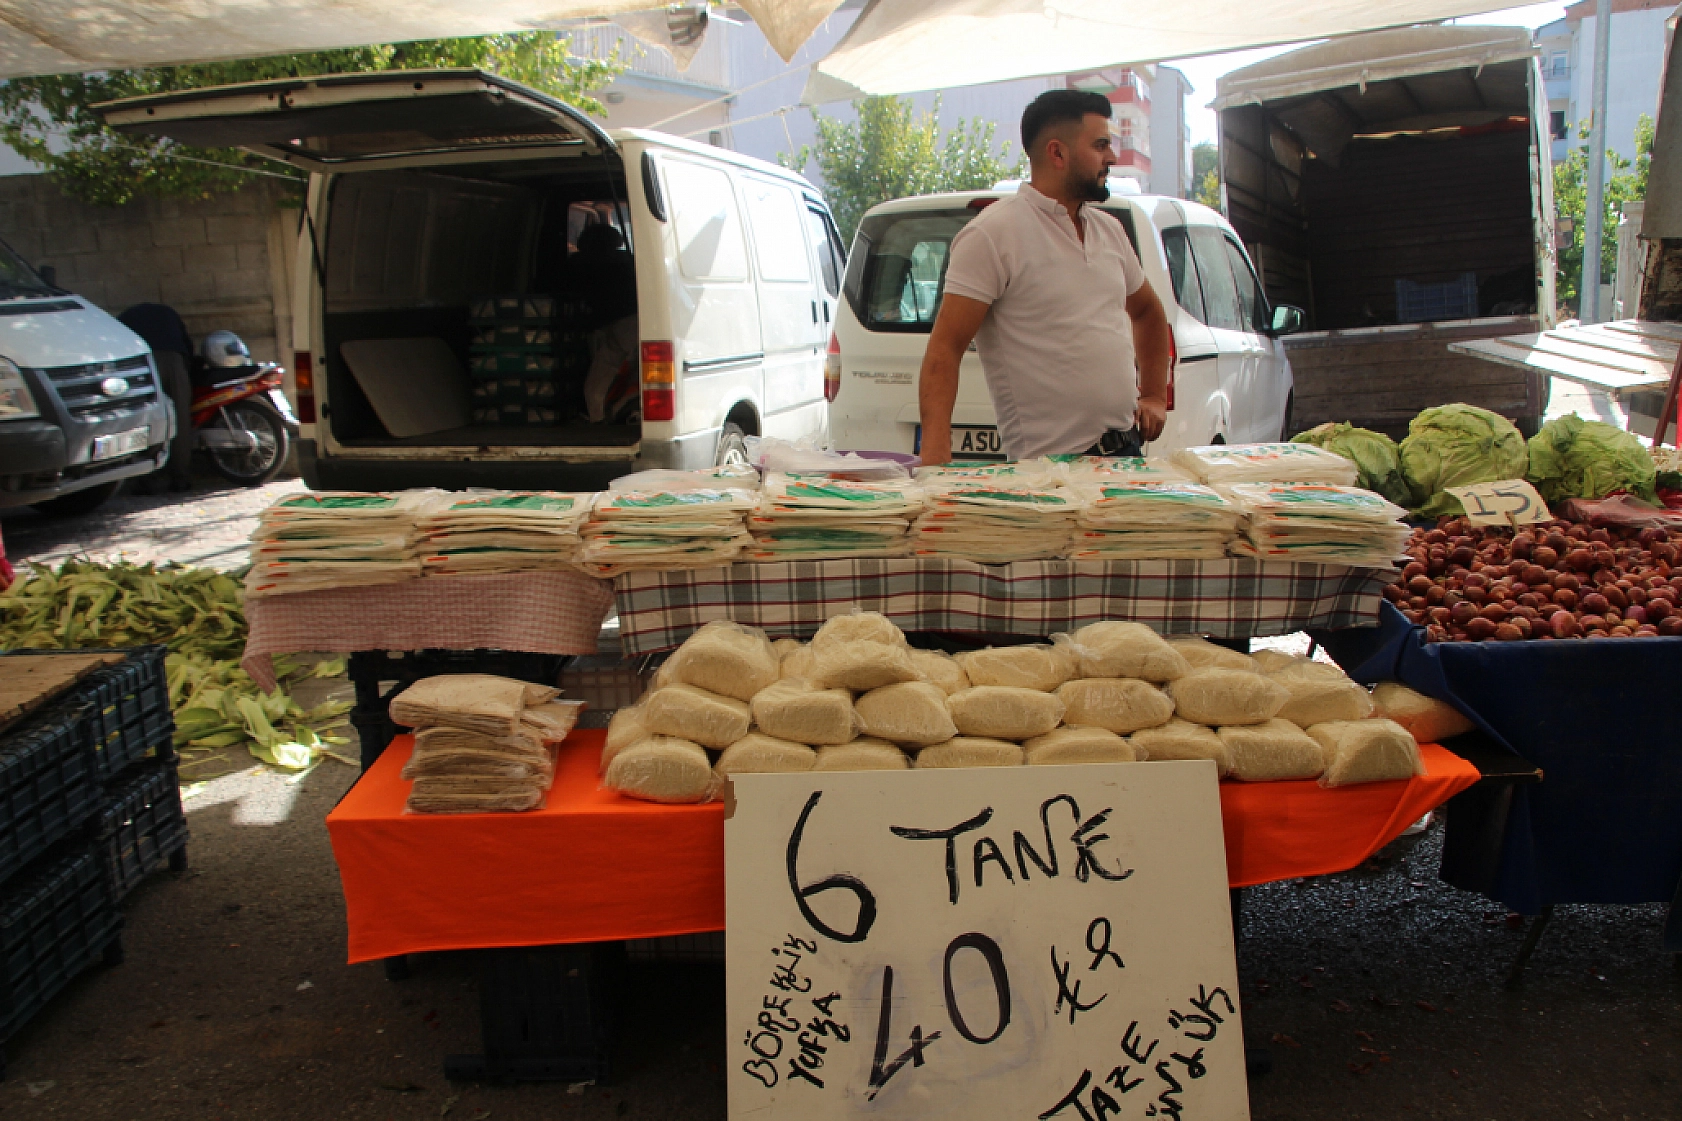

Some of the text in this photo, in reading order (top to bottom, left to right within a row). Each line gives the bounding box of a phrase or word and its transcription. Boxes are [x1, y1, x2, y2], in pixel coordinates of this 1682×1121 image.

[1462, 485, 1532, 516] 15
[785, 790, 1135, 944] 6 TANE
[866, 931, 1012, 1102] 40
